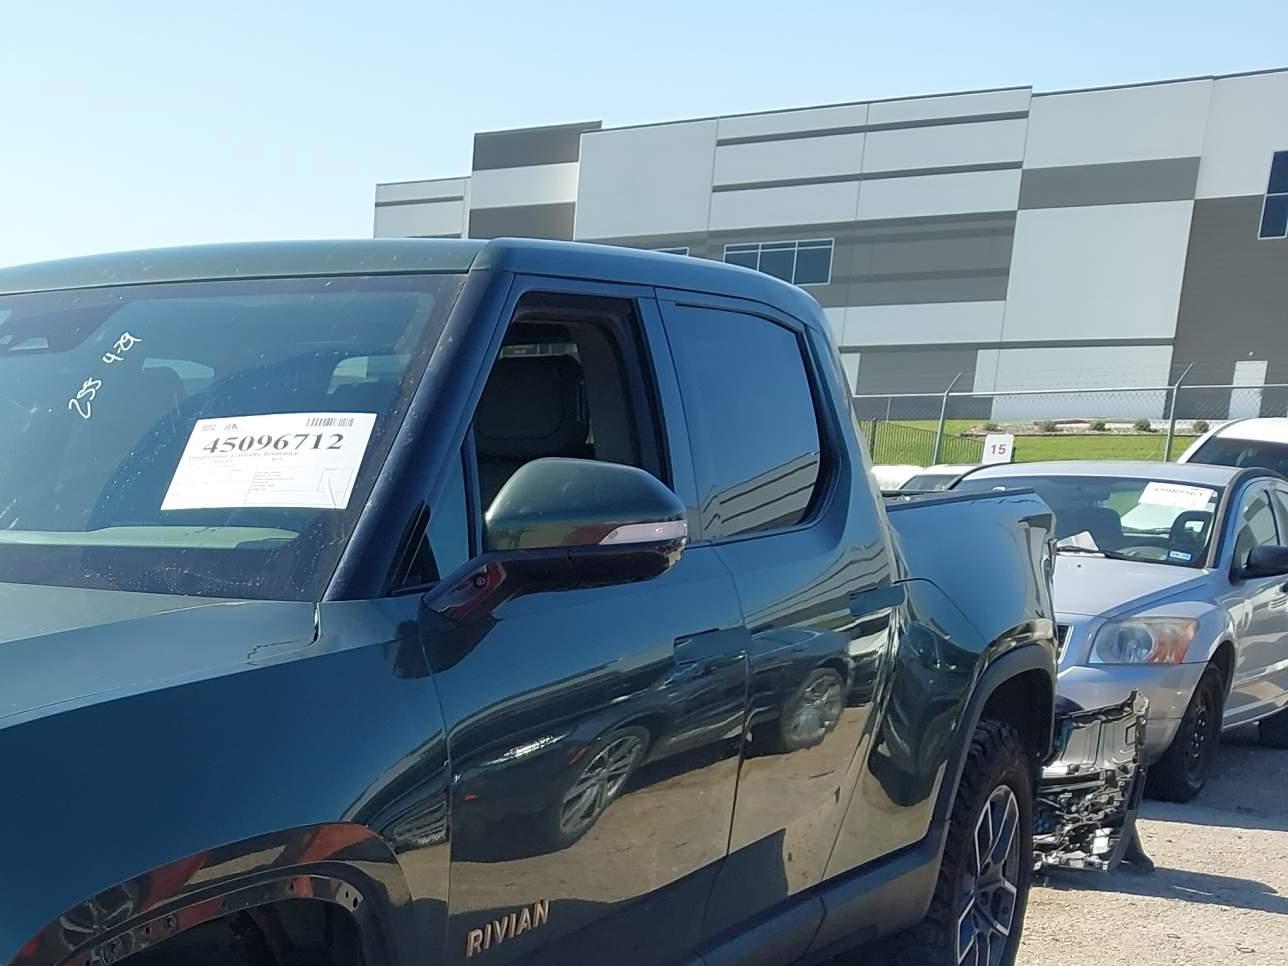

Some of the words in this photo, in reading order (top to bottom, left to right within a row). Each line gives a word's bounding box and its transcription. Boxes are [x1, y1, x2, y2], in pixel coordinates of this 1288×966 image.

[203, 433, 344, 453] 45096712
[991, 443, 1007, 455] 15
[465, 898, 549, 958] RIVIAN
